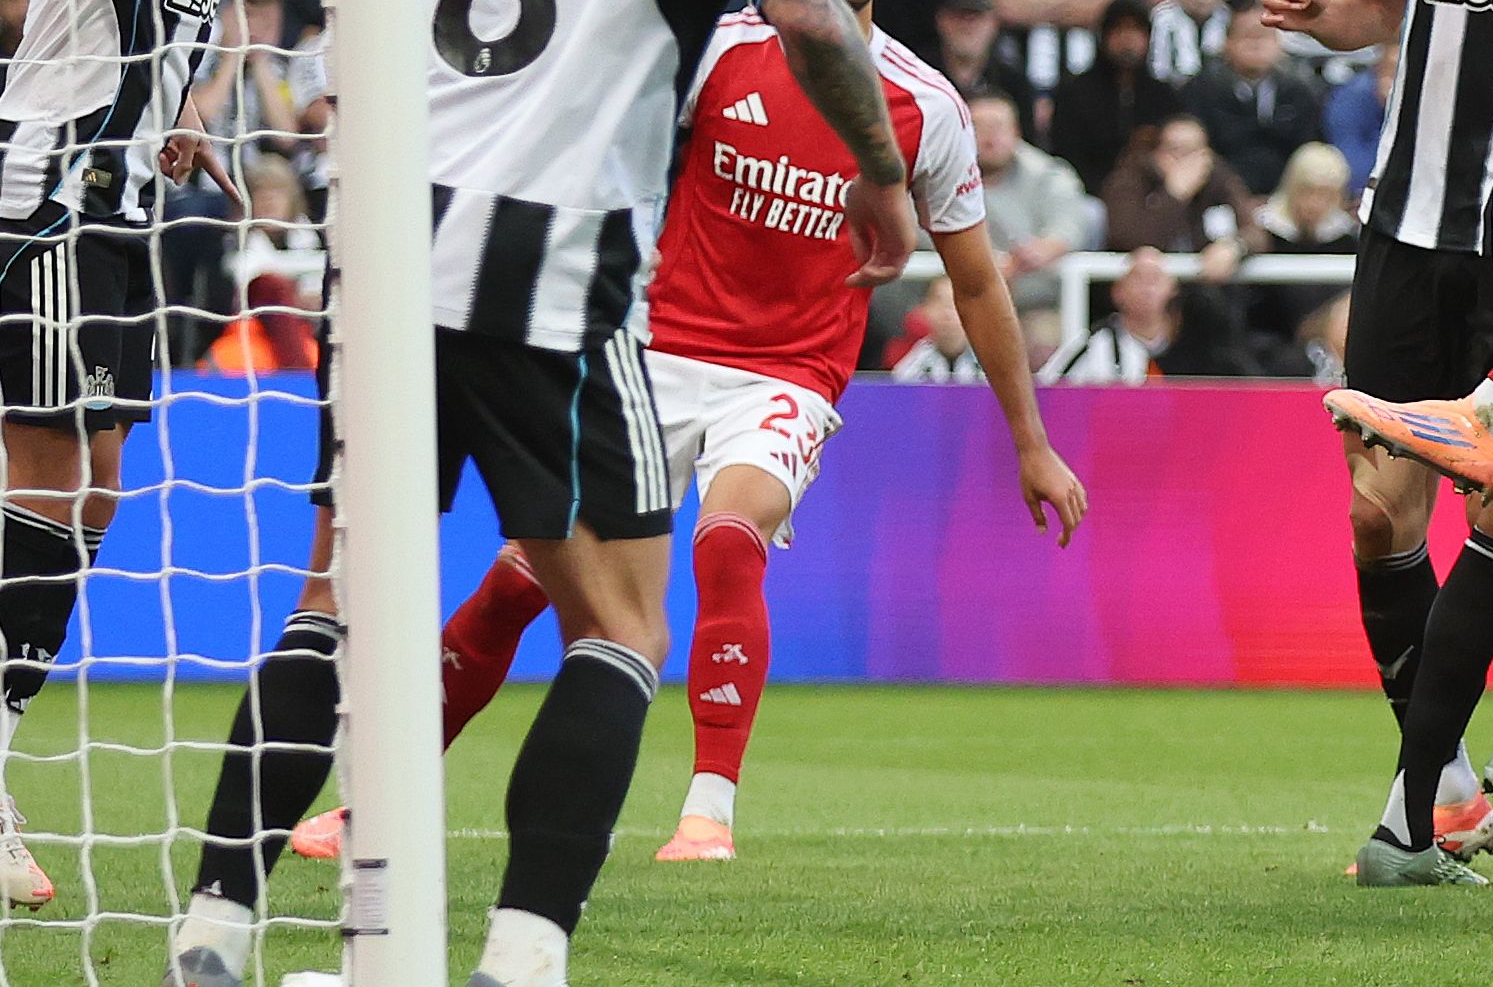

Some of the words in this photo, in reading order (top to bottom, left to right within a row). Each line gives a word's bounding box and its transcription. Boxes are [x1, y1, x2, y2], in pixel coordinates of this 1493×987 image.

[713, 140, 856, 210] Emirat
[729, 186, 766, 223] FLY
[764, 197, 845, 241] BETTER
